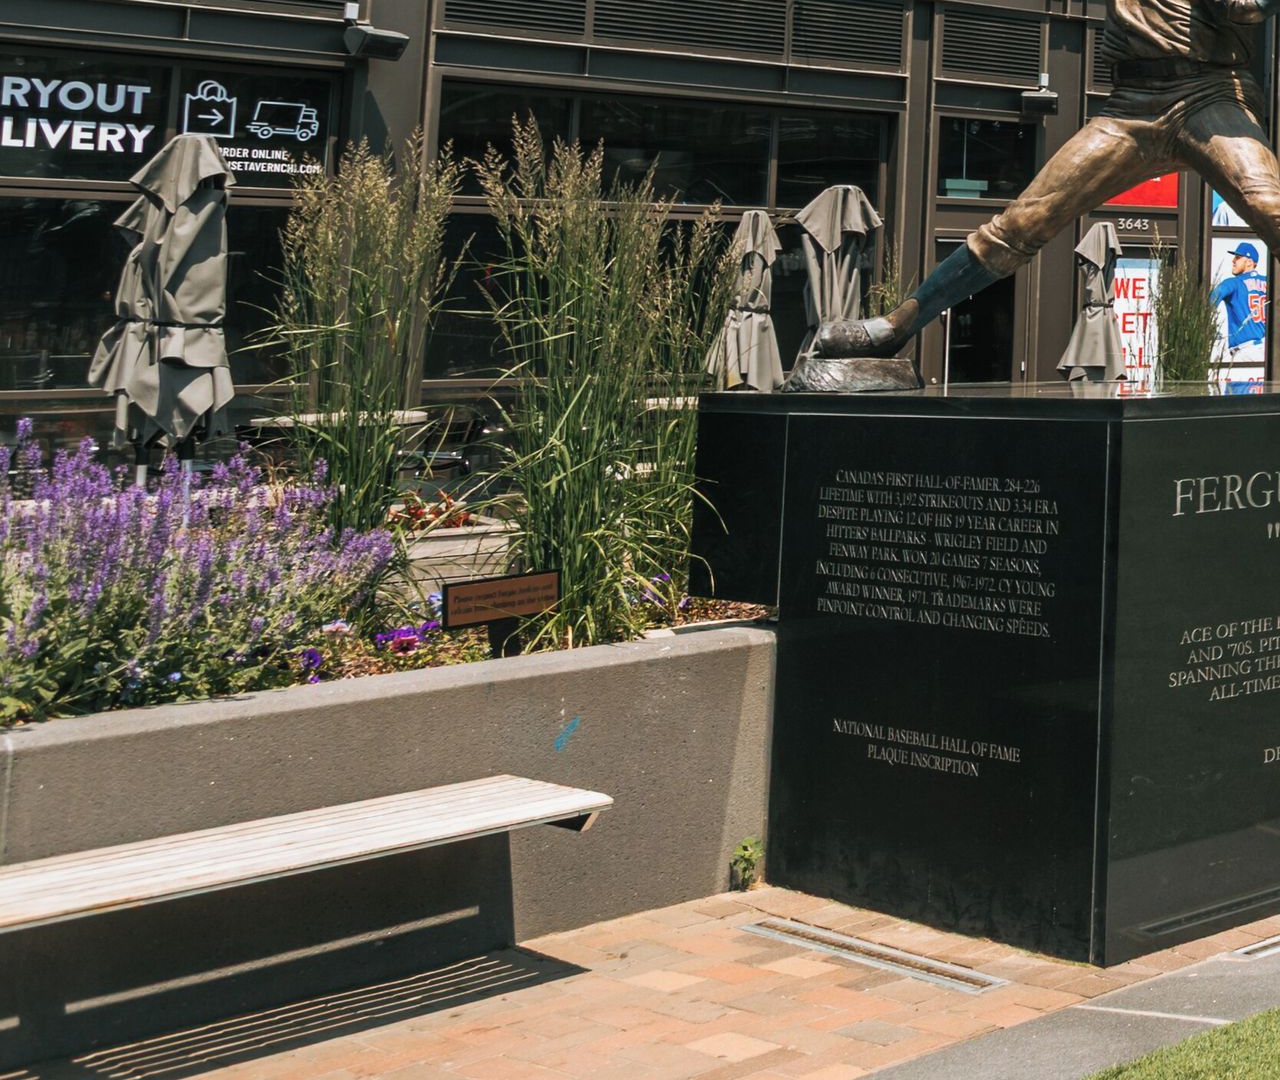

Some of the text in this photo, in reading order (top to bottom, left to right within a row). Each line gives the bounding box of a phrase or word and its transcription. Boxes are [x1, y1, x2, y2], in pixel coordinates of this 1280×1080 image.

[252, 149, 290, 160] ONLINE
[1118, 218, 1149, 230] 3643
[886, 472, 913, 487] FIRST
[1004, 479, 1040, 493] 284-226
[820, 487, 864, 502] LIFETIME
[867, 490, 892, 504] WITH
[919, 493, 983, 510] STRIKEOUTS
[986, 497, 1010, 511] AND
[1035, 500, 1058, 514] ERA
[818, 505, 1059, 535] DESPITE PLAYING 12 OF HIS 19 YEAR CAREER IN
[871, 528, 926, 544] BALLPARKS
[935, 532, 984, 549] WRIGLEY
[986, 537, 1018, 552] FIELD
[1021, 539, 1047, 554] AND
[830, 543, 870, 559] FENWAY
[902, 549, 927, 564] WON
[930, 552, 940, 565] 20
[943, 552, 980, 568] GAMES
[982, 556, 988, 570] 7
[990, 556, 1041, 577] SEASONS,
[816, 560, 869, 579] INCLUDING
[870, 571, 876, 579] 6
[877, 567, 949, 589] CONSECUTIVE,
[999, 578, 1011, 593] CY
[1016, 580, 1055, 597] YOUNG
[826, 582, 859, 596] AWARD
[862, 585, 905, 604] WINNER,
[932, 592, 1006, 612] TRADEMARKS
[1009, 599, 1041, 616] WERE
[817, 598, 864, 616] PINPOINT
[866, 604, 915, 622] CONTROL
[918, 610, 940, 624] AND
[943, 612, 1003, 632] CHANGING
[1180, 627, 1212, 645] ACE
[1217, 622, 1238, 639] OF
[1242, 618, 1272, 635] THE
[1187, 646, 1223, 664] AND
[1169, 660, 1251, 687] SPANNING
[1209, 675, 1280, 701] ALL-TIME
[833, 719, 1021, 763] NATIONAL BASEBALL HALL OF FAME
[868, 744, 979, 776] PLAQUE INSCRIPTION
